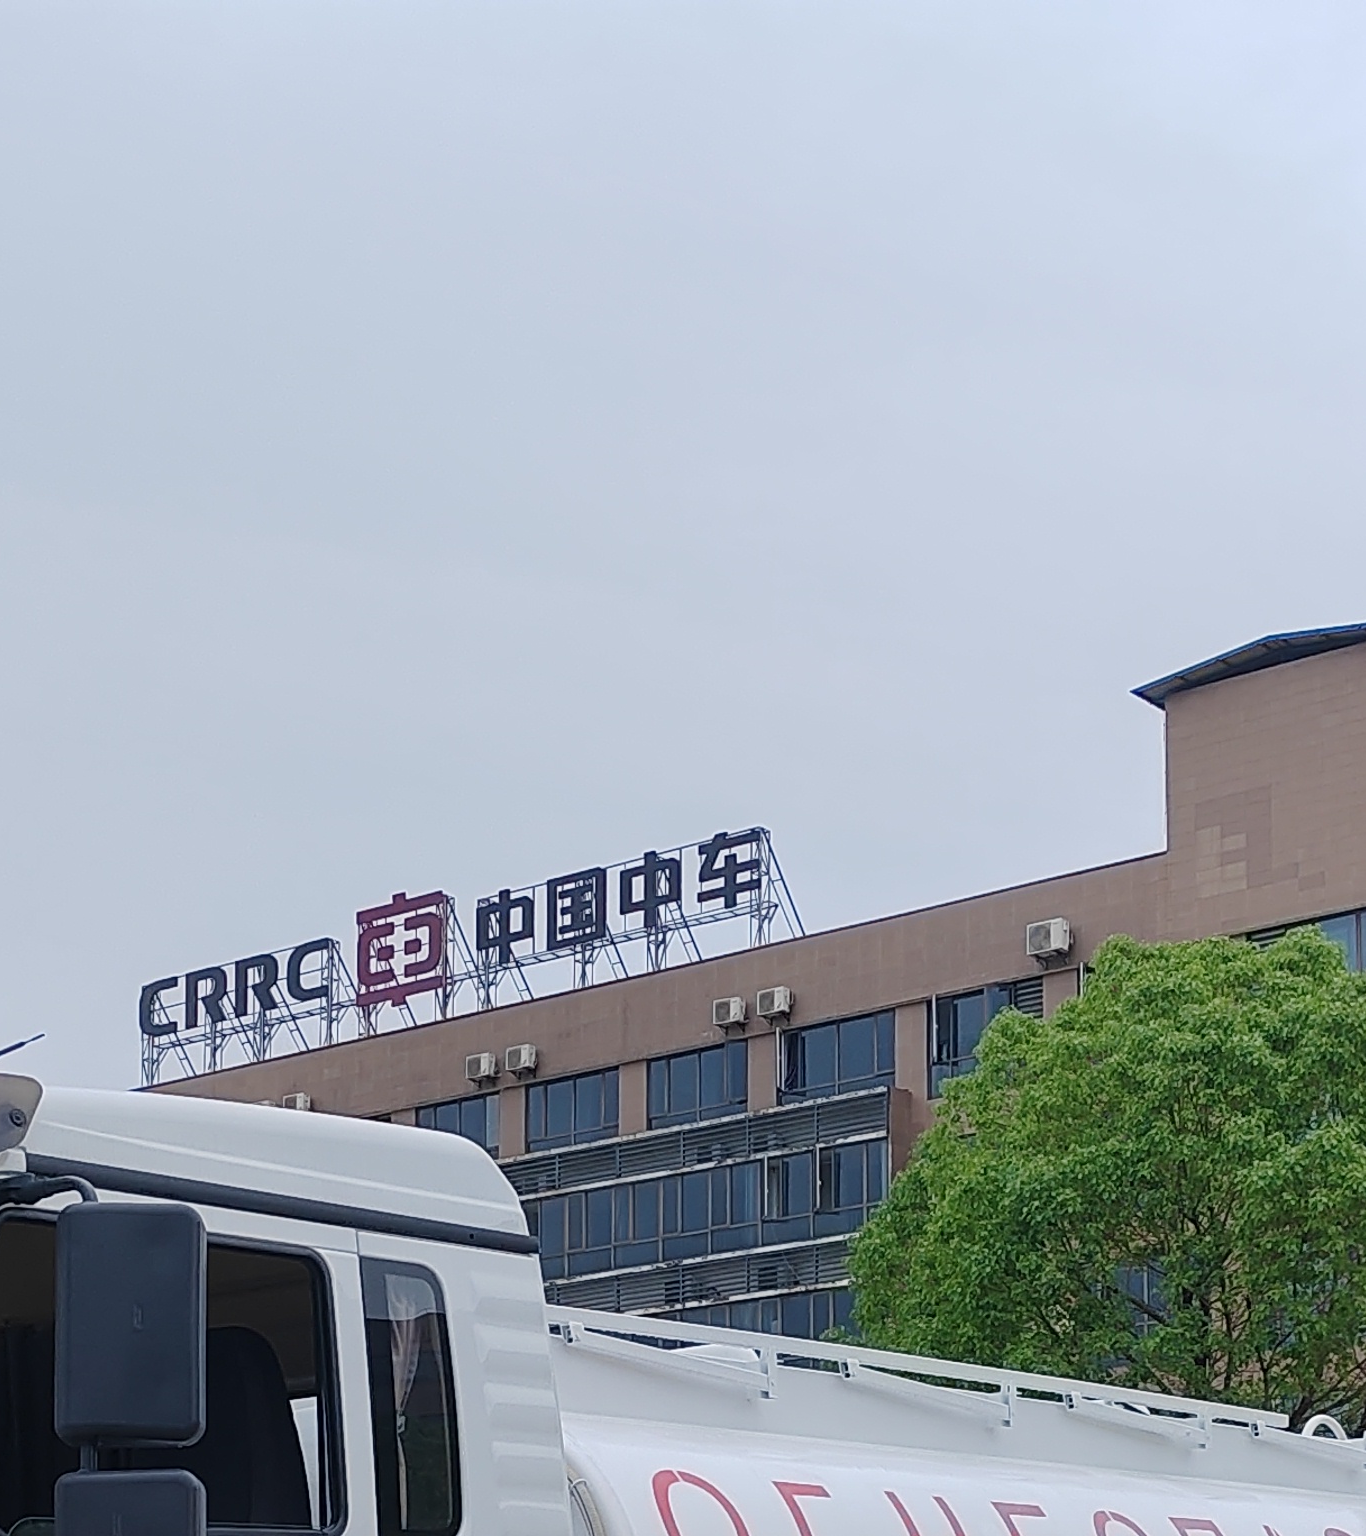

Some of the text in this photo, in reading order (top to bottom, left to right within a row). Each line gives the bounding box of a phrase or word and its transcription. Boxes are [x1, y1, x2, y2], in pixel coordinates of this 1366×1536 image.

[476, 832, 761, 964] 中国中车
[140, 938, 329, 1036] CRRC
